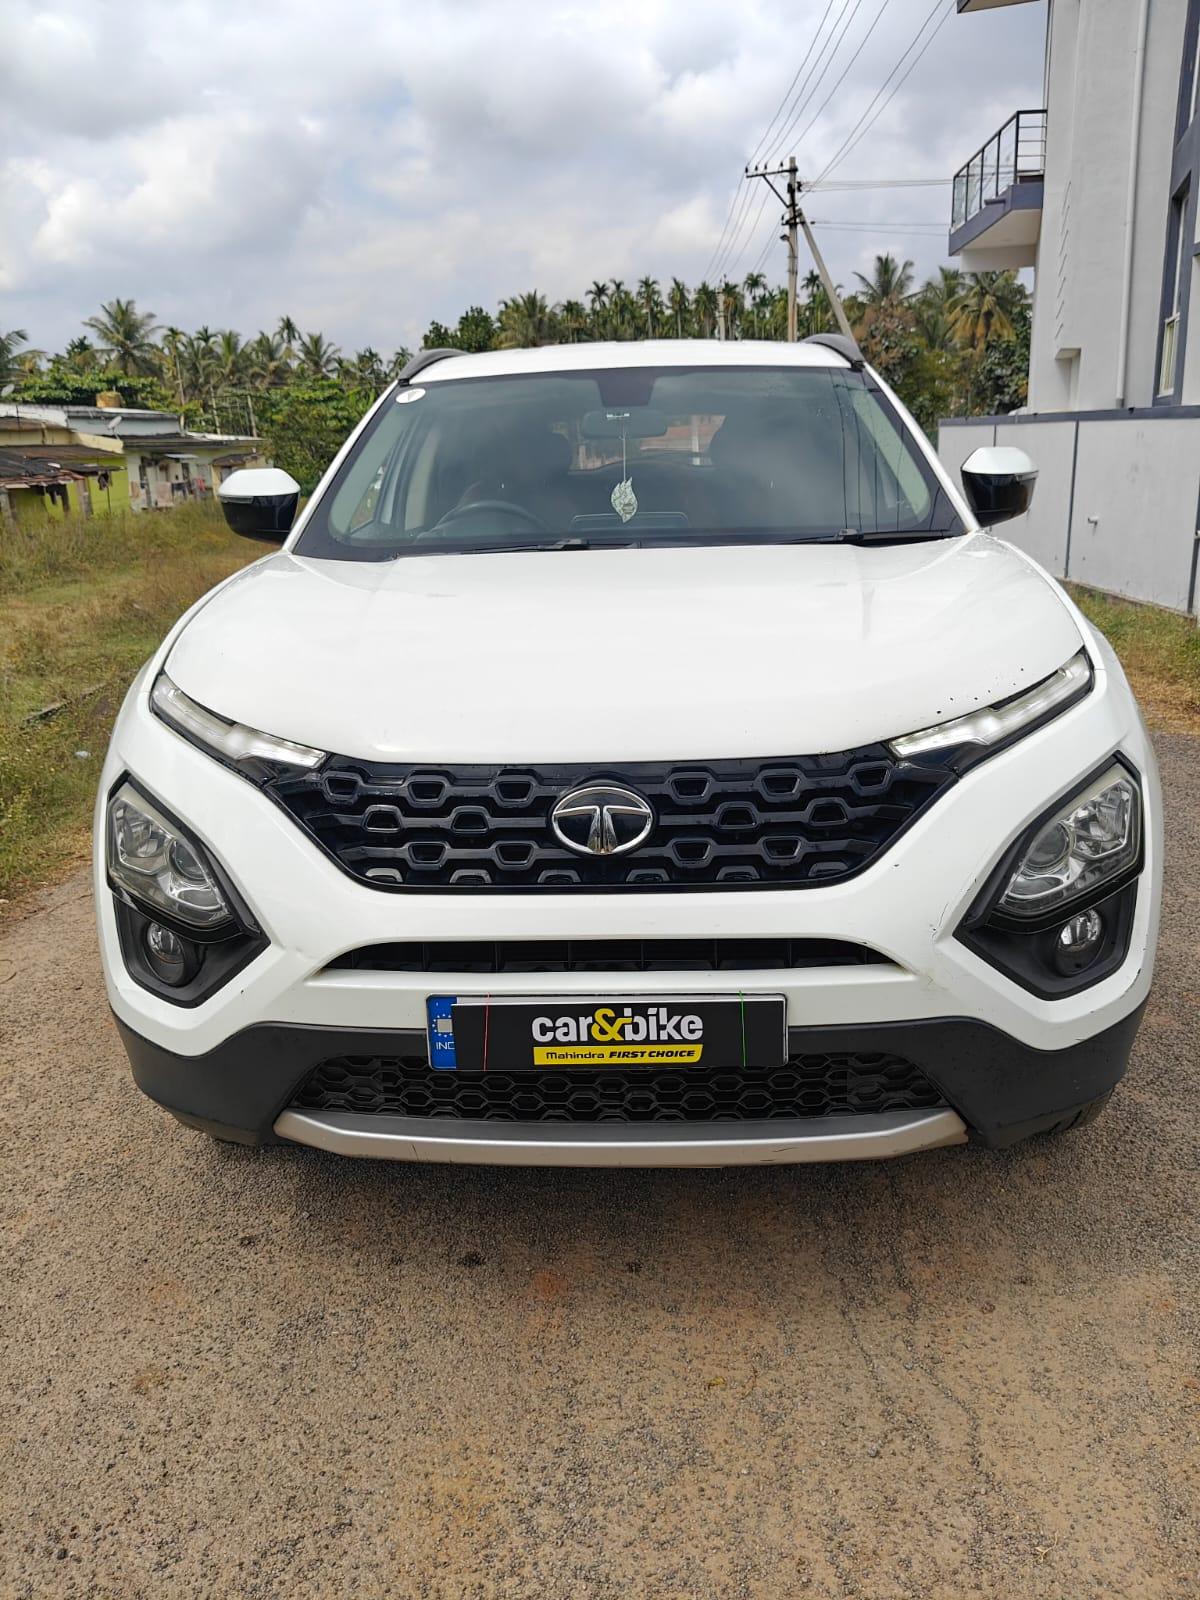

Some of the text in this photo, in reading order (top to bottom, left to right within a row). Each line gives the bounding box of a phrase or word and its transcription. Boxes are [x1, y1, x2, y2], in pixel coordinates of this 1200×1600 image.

[531, 1007, 703, 1042] car&bike
[546, 1050, 695, 1060] Mahindra FIRST CHOICE
